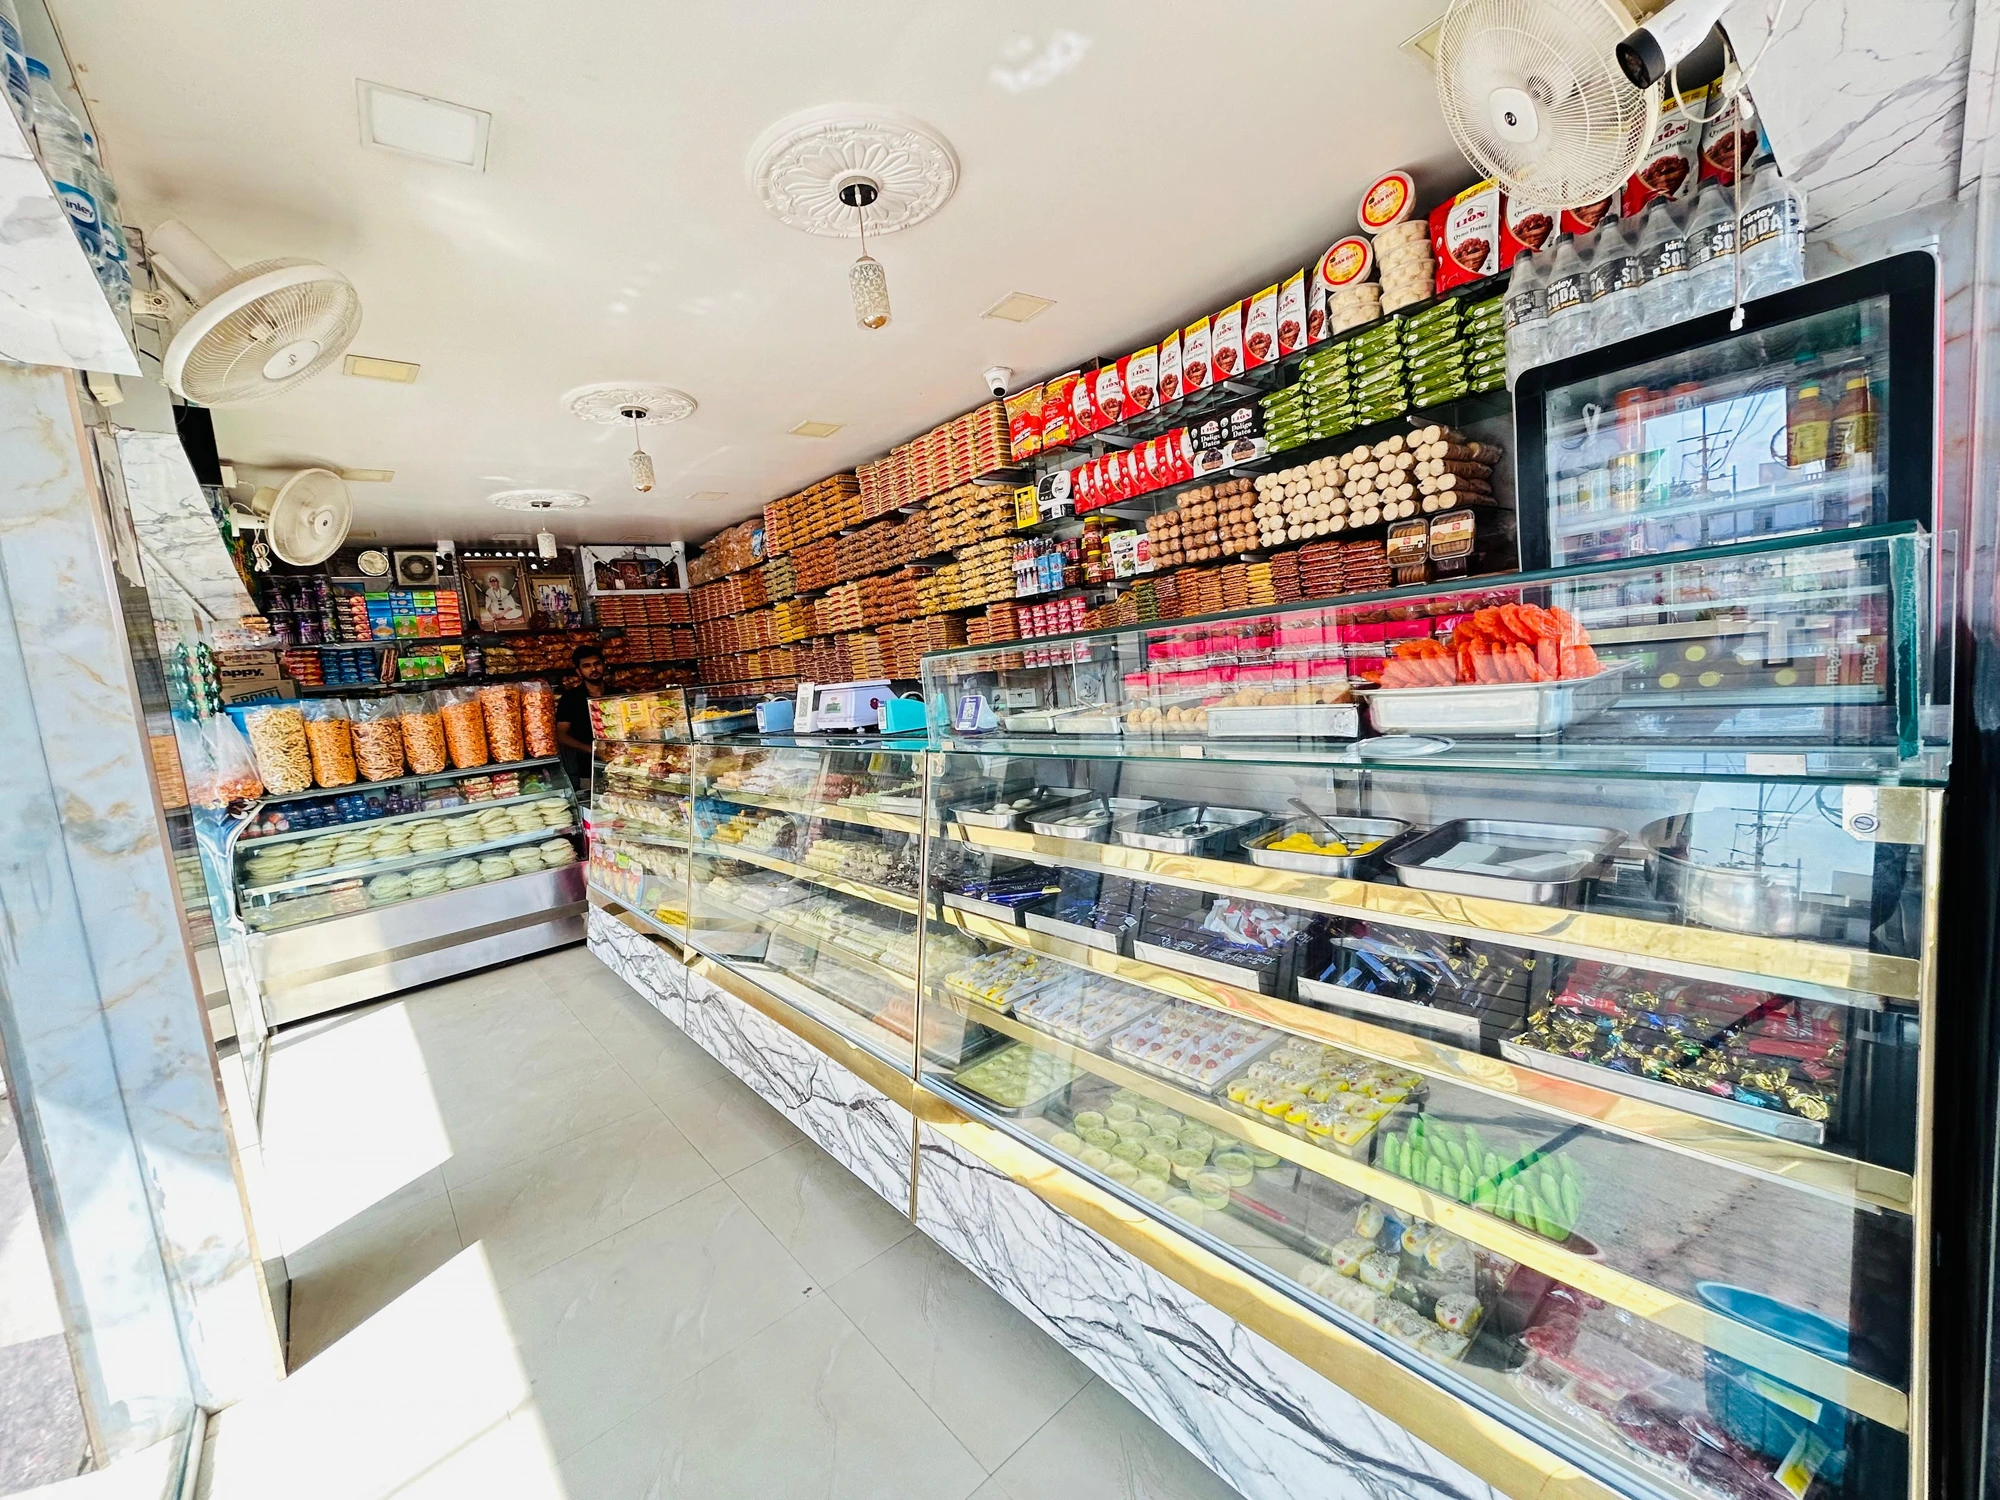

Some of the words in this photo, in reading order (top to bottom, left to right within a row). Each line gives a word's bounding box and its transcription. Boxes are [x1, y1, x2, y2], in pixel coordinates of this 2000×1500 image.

[1657, 123, 1686, 142] ION
[64, 197, 94, 218] inley
[1743, 205, 1775, 226] kinley
[1456, 210, 1486, 228] LION
[1741, 213, 1783, 245] SODA
[1712, 233, 1735, 251] SO
[1547, 285, 1580, 311] SODA
[1132, 368, 1150, 377] LION
[1101, 381, 1120, 390] LION
[1232, 428, 1252, 438] Dates
[222, 668, 265, 678] appy.
[1826, 646, 1842, 684] maaza
[1861, 644, 1879, 684] maaza
